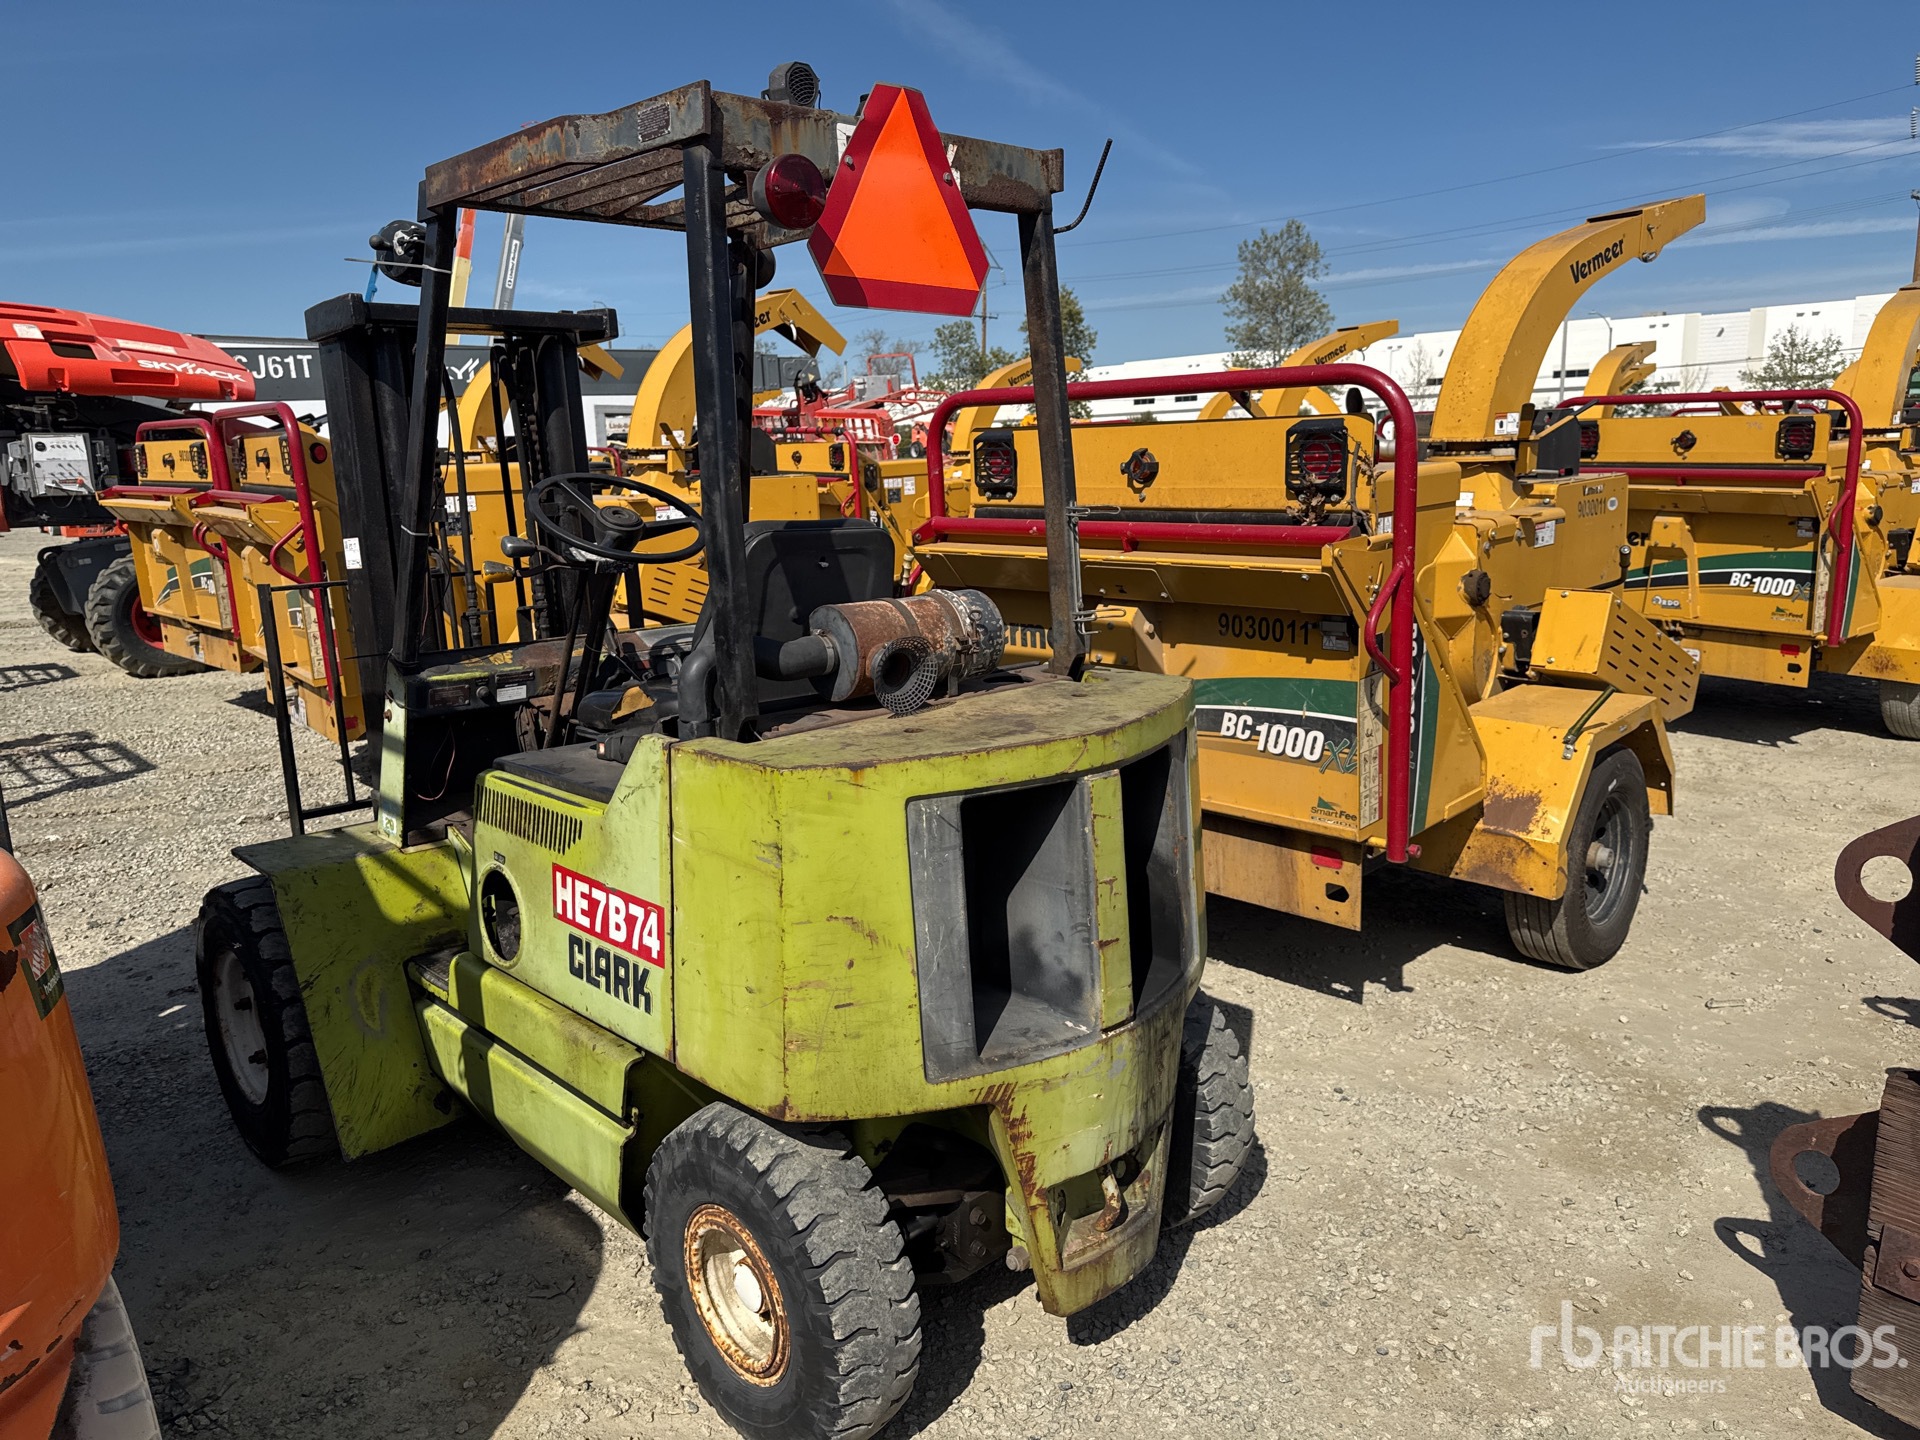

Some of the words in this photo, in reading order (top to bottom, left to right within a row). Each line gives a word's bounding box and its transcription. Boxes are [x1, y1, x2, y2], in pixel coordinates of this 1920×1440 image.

[1570, 239, 1624, 284] Vermeer
[137, 359, 247, 383] SKYJACK
[1314, 343, 1347, 365] Vermeer
[1217, 612, 1309, 645] 9030011
[555, 870, 661, 960] HE7B74
[568, 932, 653, 1016] CLARK
